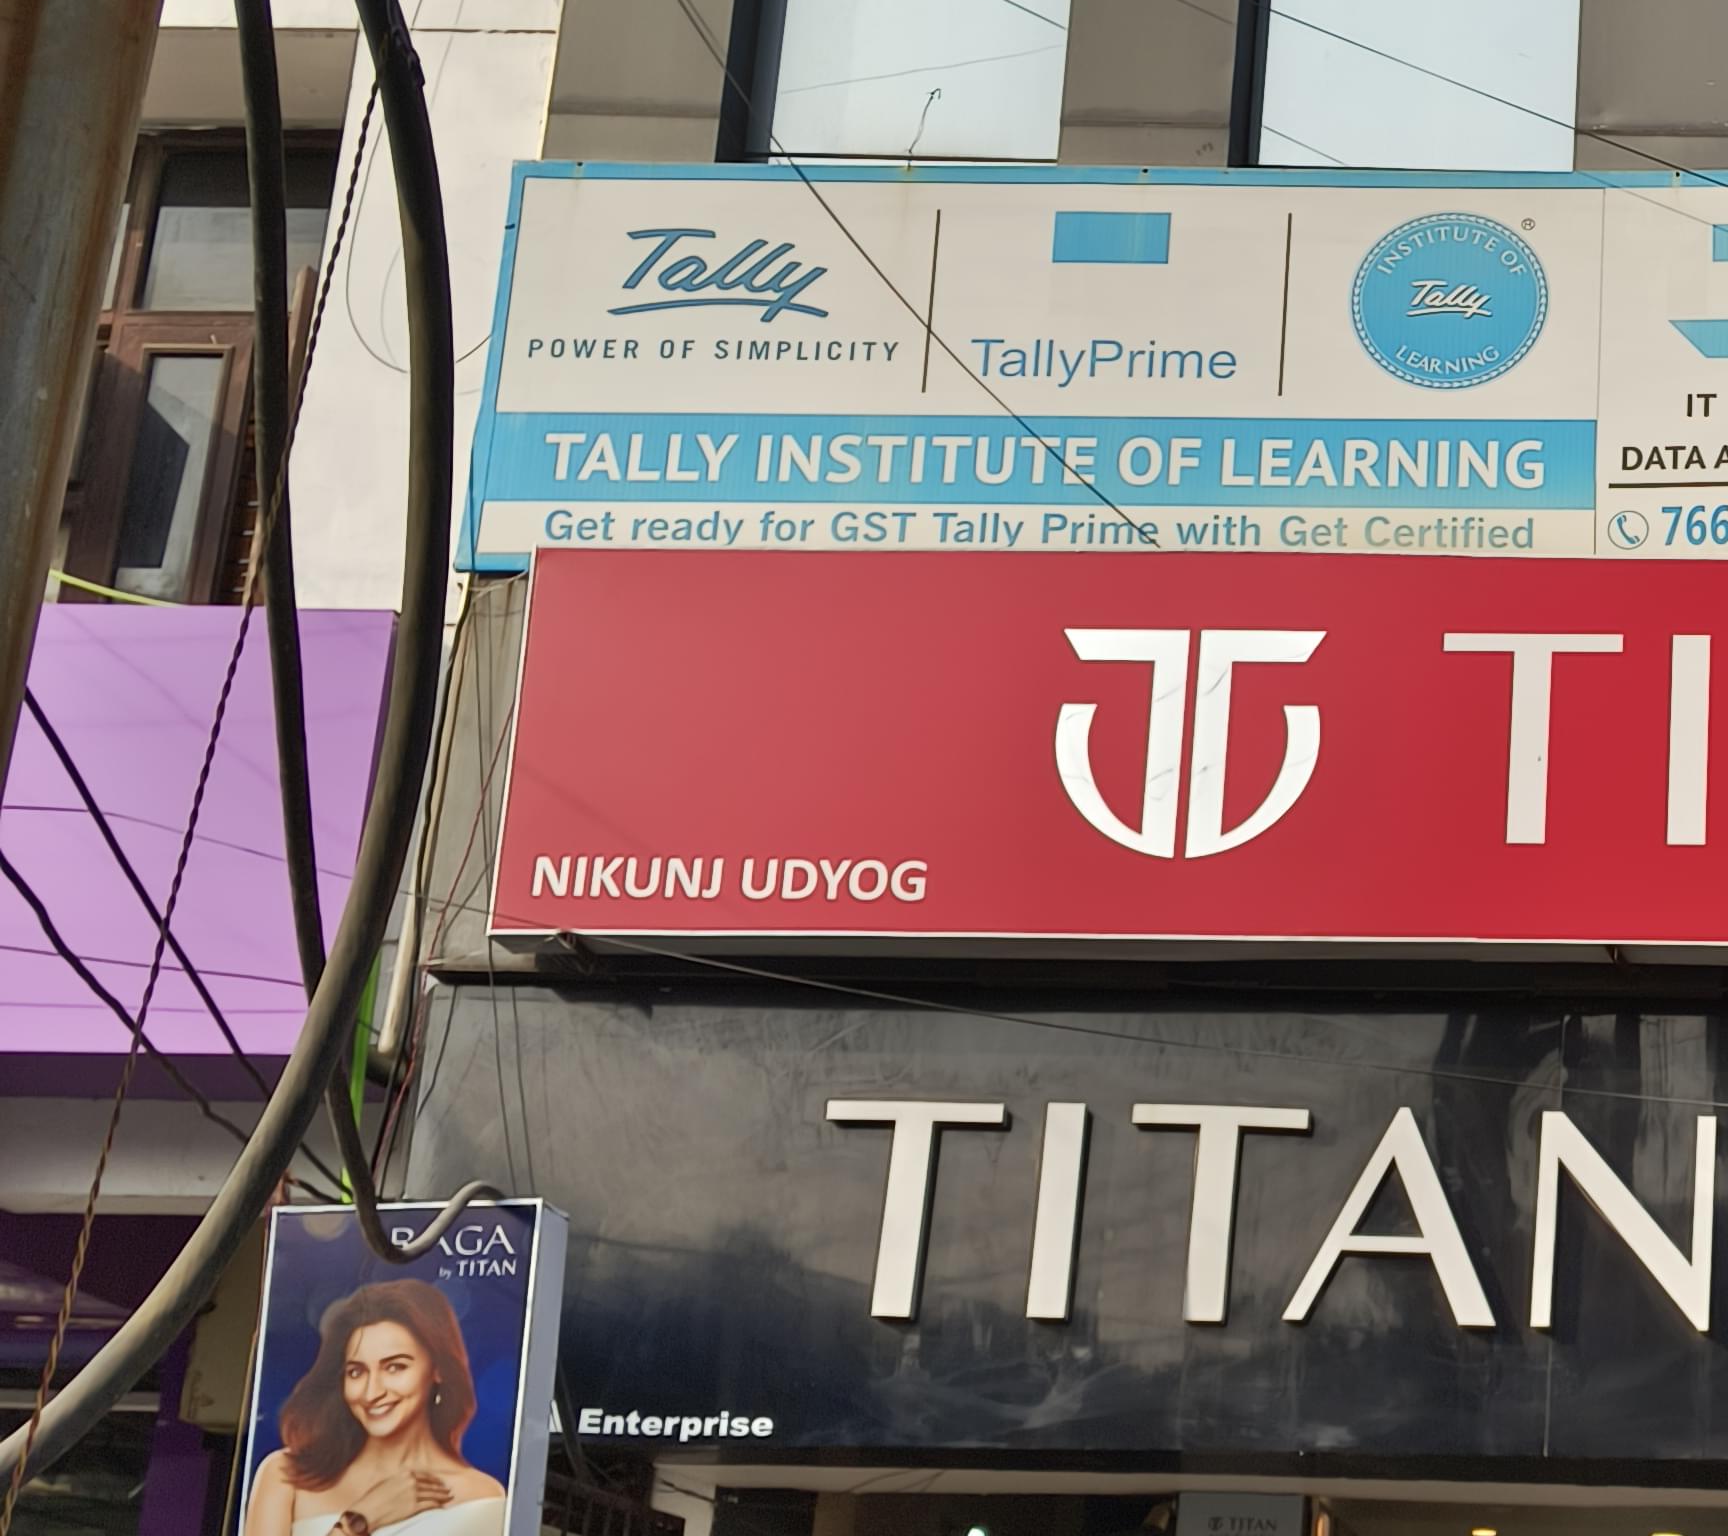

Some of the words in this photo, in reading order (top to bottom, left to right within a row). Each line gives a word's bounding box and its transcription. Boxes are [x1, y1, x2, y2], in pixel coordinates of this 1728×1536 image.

[1377, 225, 1498, 277] INSTITUTE
[1499, 249, 1528, 278] OF
[610, 228, 828, 322] Tally
[1406, 279, 1493, 318] Tally
[528, 338, 640, 360] POWER
[660, 339, 696, 360] OF
[714, 339, 899, 362] SIMPLICITY
[971, 337, 1238, 388] TallyPrime
[1395, 344, 1501, 375] LEARNING
[1685, 392, 1718, 418] IT
[545, 432, 740, 483] TALLY
[755, 434, 1099, 486] INSTITUTE
[1118, 436, 1203, 487] OF
[1220, 437, 1547, 489] LEARNING
[1620, 445, 1707, 471] DATA
[545, 509, 616, 543] Get
[630, 510, 744, 547] ready
[759, 509, 815, 543] for
[830, 511, 917, 544] GST
[931, 512, 1025, 547] Tally
[1041, 513, 1160, 546] Prime
[1176, 514, 1262, 547] with
[1279, 515, 1349, 549] Get
[1363, 515, 1535, 550] Certified
[531, 855, 725, 901] NIKUNJ
[739, 857, 929, 902] UDYOG
[825, 1099, 1718, 1332] TITAN
[455, 1259, 517, 1277] TITAN
[577, 1409, 774, 1442] Enterprise
